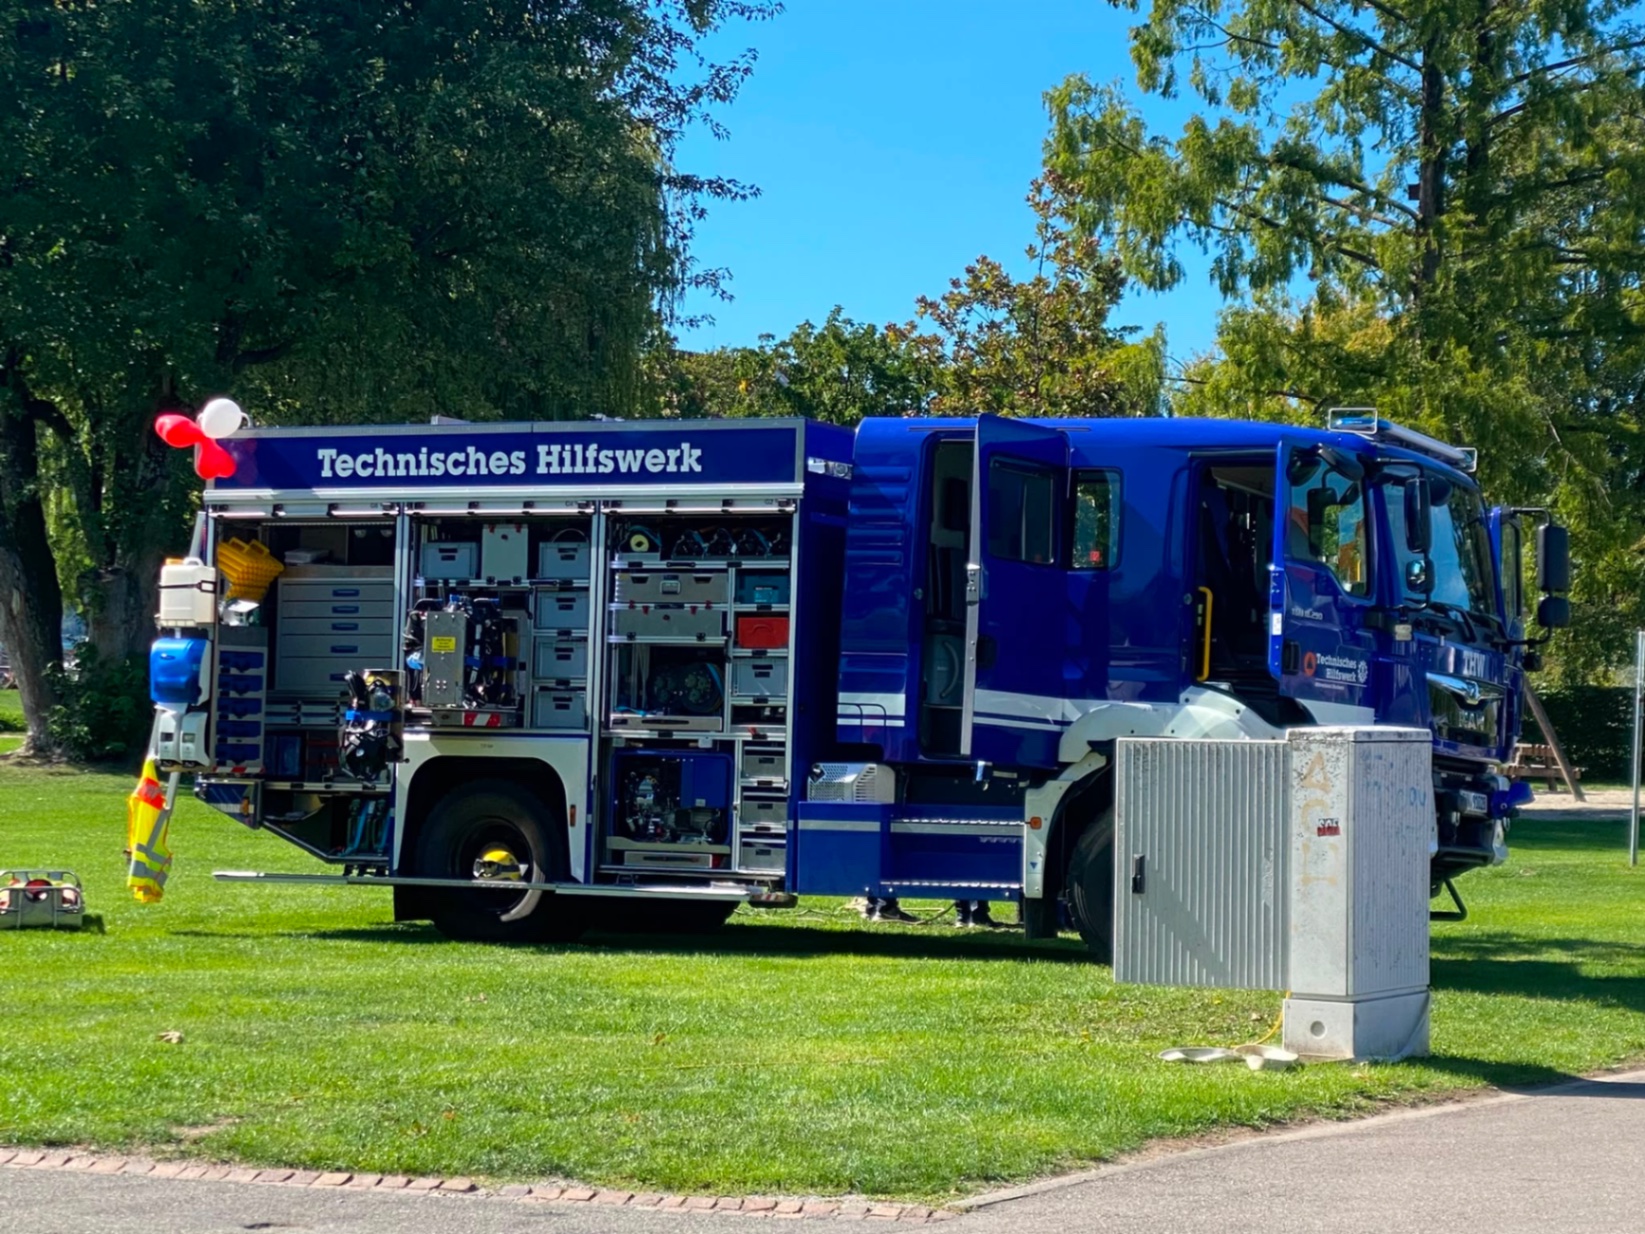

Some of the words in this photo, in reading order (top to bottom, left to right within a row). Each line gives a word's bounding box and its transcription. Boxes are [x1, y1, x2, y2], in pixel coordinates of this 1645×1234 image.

[317, 446, 526, 477] Technisches
[536, 442, 702, 474] Hilfswerk
[1316, 652, 1357, 670] Technisches
[1462, 650, 1486, 678] THW
[1326, 667, 1357, 682] Hilfswerk
